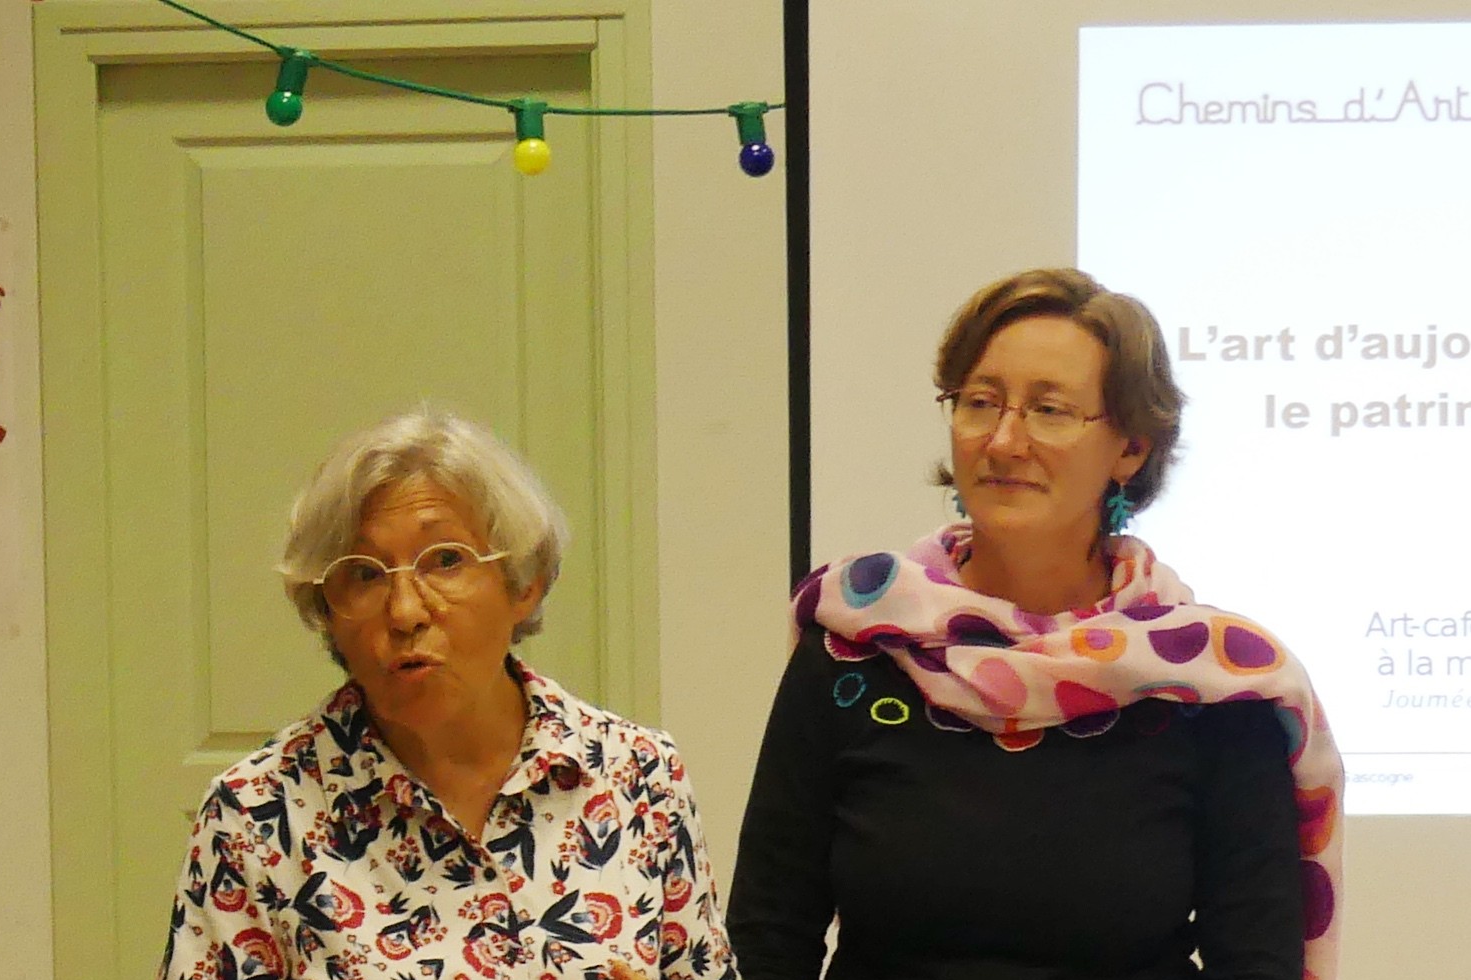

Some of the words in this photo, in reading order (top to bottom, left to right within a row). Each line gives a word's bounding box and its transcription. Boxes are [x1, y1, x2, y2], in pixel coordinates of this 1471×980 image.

[1135, 81, 1318, 126] Chemins
[1178, 325, 1296, 363] L'art
[1314, 323, 1471, 370] d'aujo
[1264, 393, 1311, 430] le
[1365, 611, 1471, 638] Art-caf
[1377, 647, 1395, 677] à
[1407, 648, 1434, 677] la
